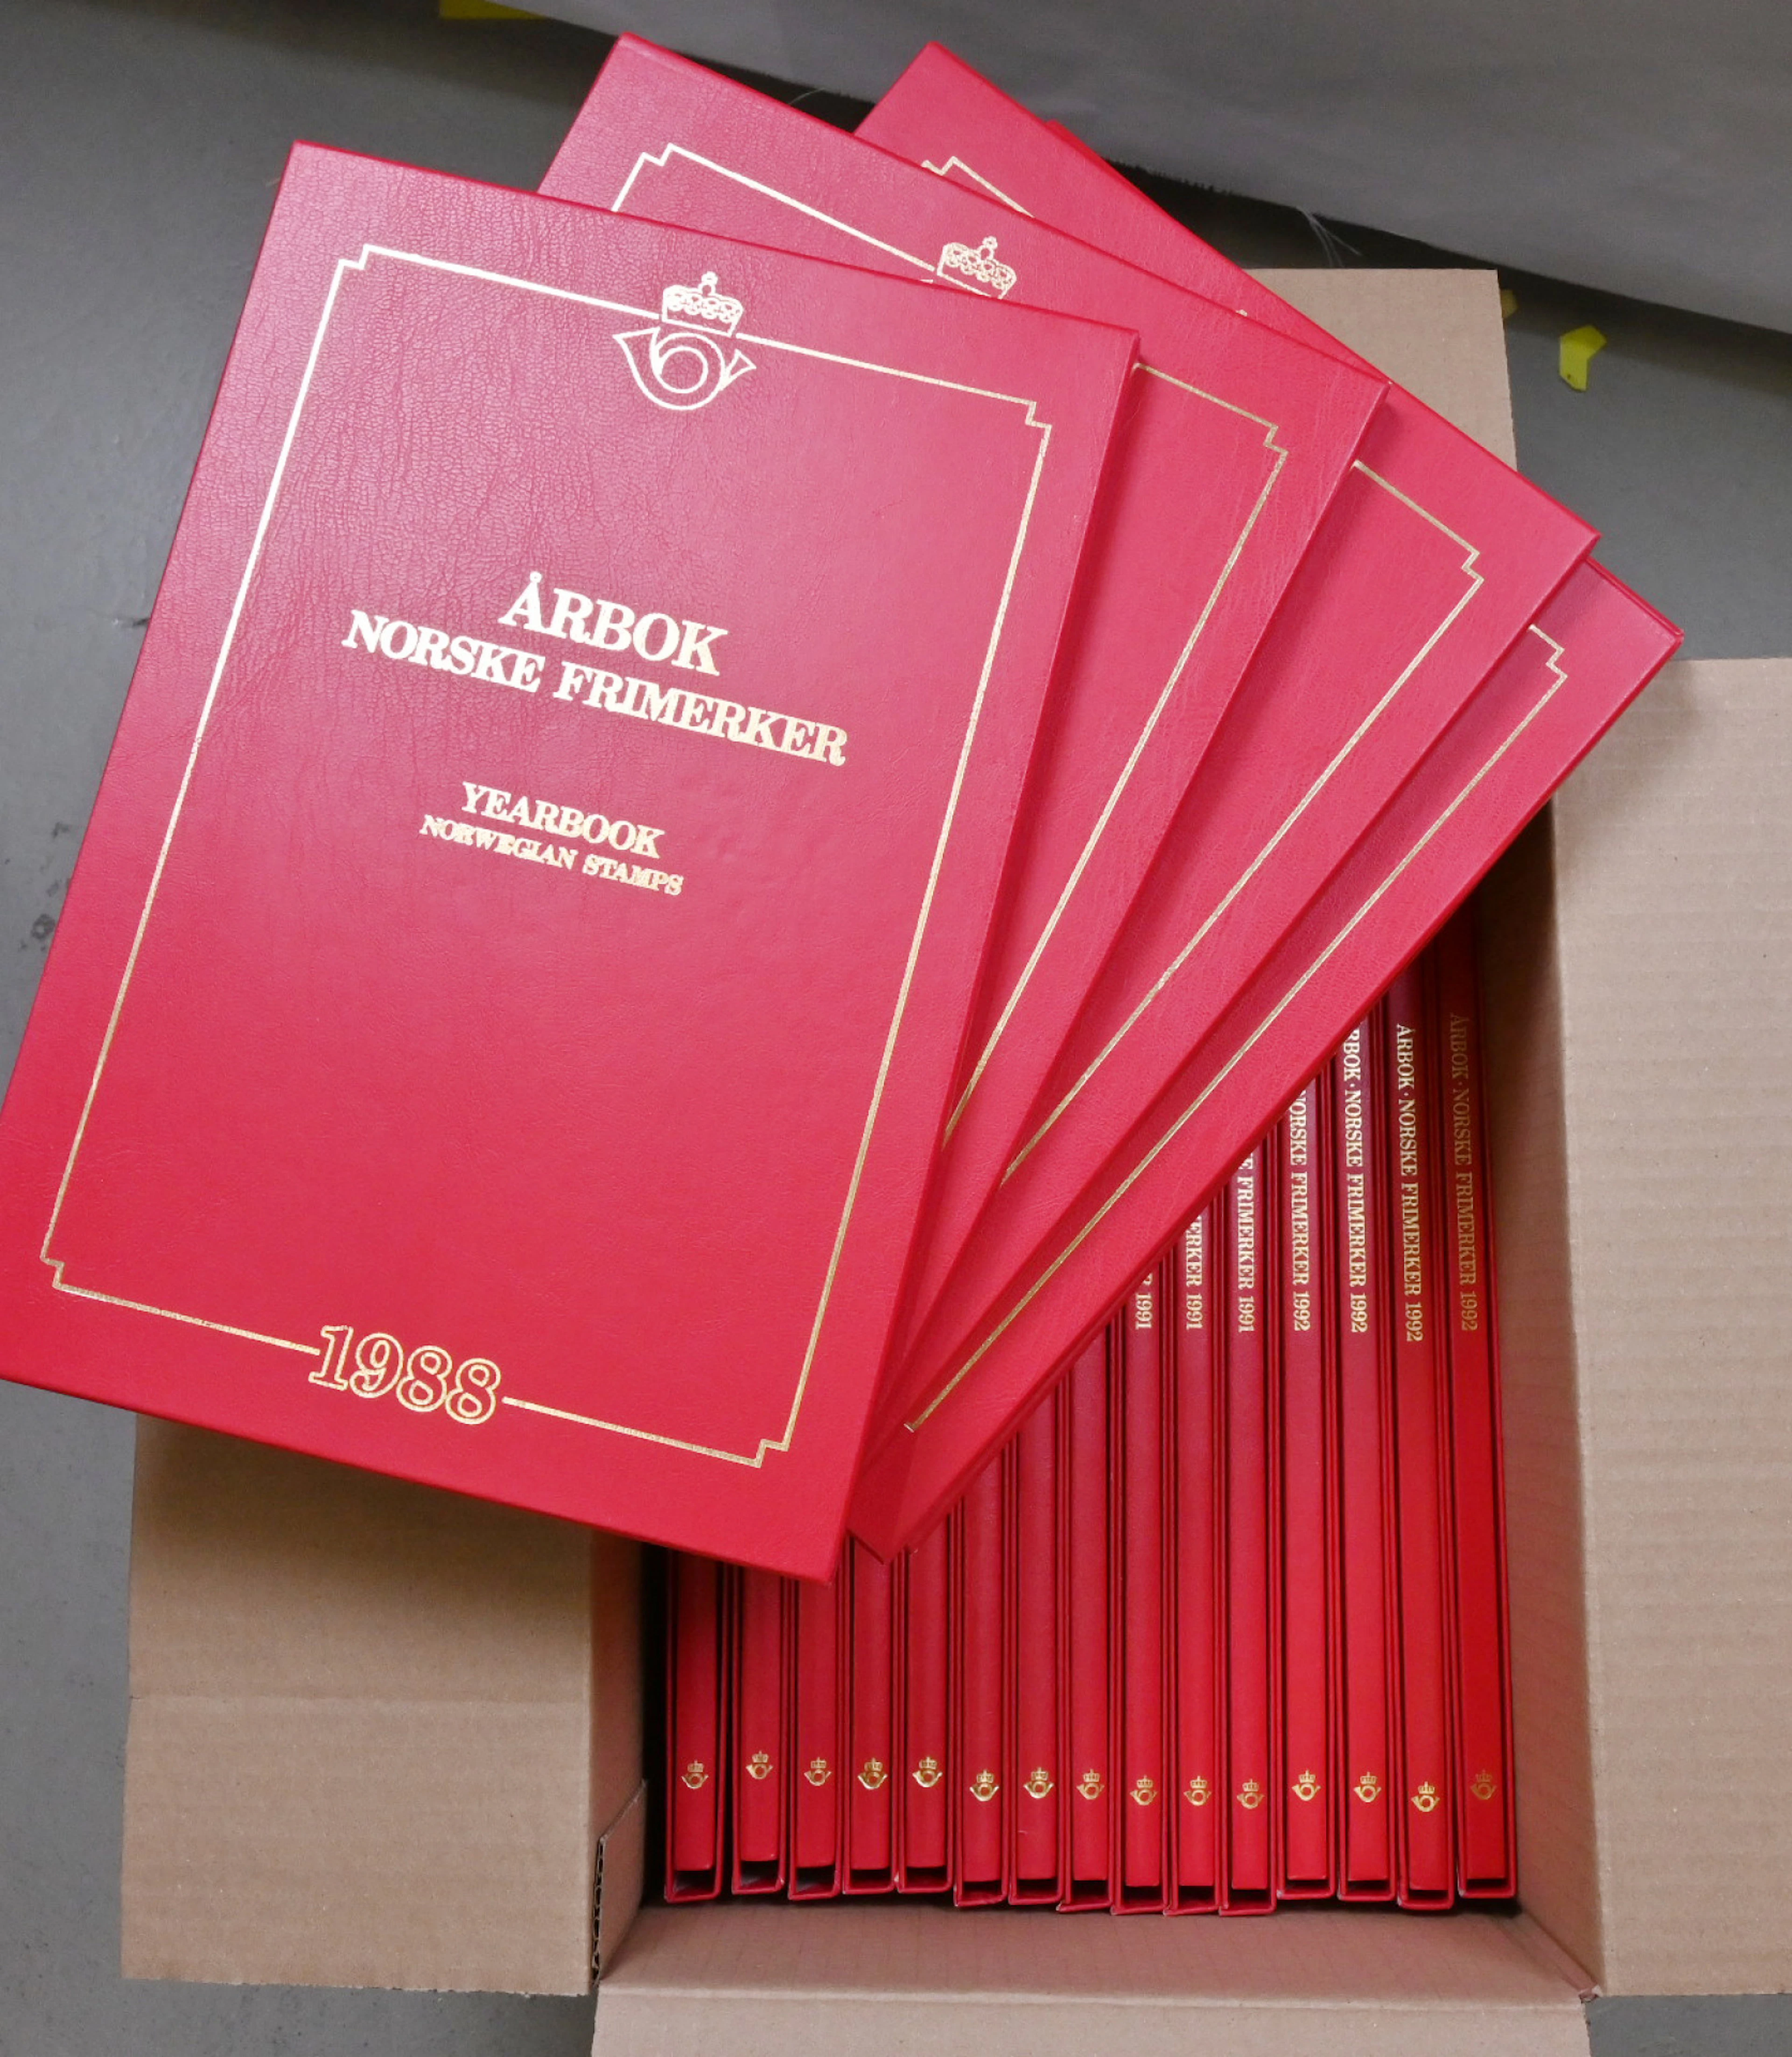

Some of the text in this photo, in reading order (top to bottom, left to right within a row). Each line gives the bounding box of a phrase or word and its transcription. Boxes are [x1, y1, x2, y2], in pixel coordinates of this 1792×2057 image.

[498, 571, 728, 676] ÅRBOK
[342, 609, 848, 766] NORSKE FRIMERKER
[420, 815, 684, 896] NORWEGIAN STAMPS
[462, 781, 665, 858] YEARBOOK
[1399, 1099, 1418, 1176] NORSKE
[1453, 1088, 1472, 1165] NORSKE
[1344, 1028, 1368, 1333] RBOK NORSKE FRIMERKER 1992
[1186, 1215, 1203, 1330] ERKER 1991
[1237, 1176, 1254, 1290] FRIMERKER
[1291, 1172, 1309, 1285] FRIMERKER
[1401, 1182, 1421, 1296] FRIMERKER
[1456, 1172, 1477, 1286] FRIMERKER
[1135, 1292, 1153, 1330] 1991
[1238, 1296, 1255, 1333] 1991
[1293, 1291, 1311, 1331] 1992
[1405, 1302, 1423, 1342] 1992
[1460, 1291, 1478, 1331] 1992
[308, 1325, 502, 1425] 1988
